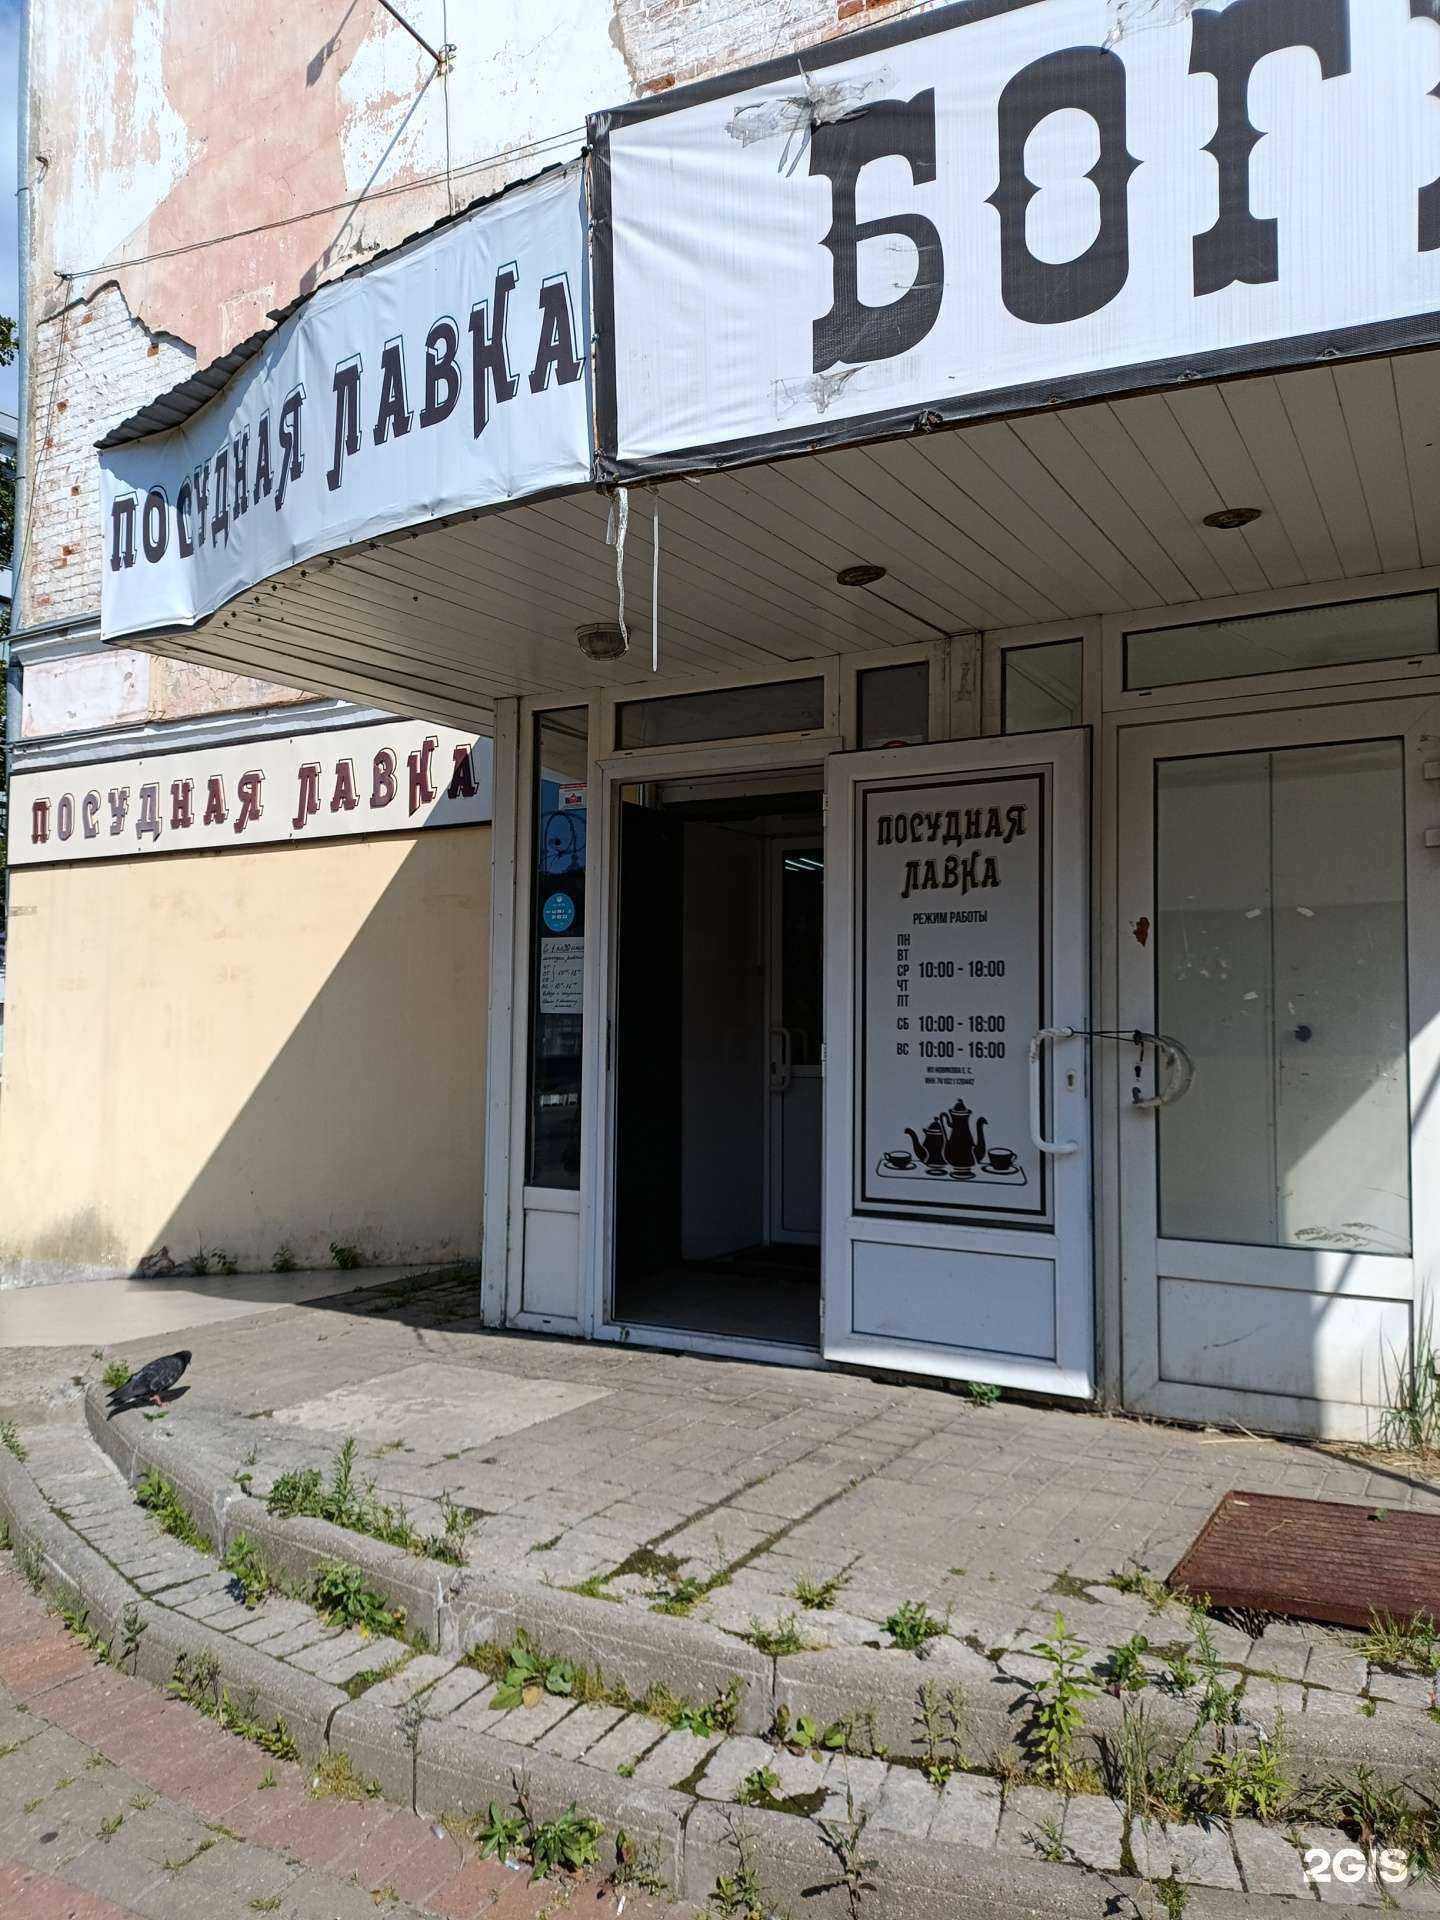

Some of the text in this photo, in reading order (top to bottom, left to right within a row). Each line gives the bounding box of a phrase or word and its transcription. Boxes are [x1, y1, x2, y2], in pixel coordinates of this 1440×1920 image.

[809, 0, 1440, 374] БОГ
[110, 259, 586, 573] ПОСУДНАЯ ЛАВКА
[31, 735, 480, 845] ПОСУДНАЯ ЛАВКА
[877, 803, 1028, 848] ПОСУДНАЯ
[901, 849, 1001, 899] ЛАВКА
[912, 909, 988, 925] РЕЖИМ РАБОТЫ
[896, 933, 911, 947] ПН
[896, 949, 909, 962] ВТ
[896, 964, 910, 977] СР
[918, 961, 955, 978] 10:00
[968, 960, 1006, 977] 18:00
[896, 979, 909, 992] ЧТ
[896, 994, 910, 1007] ПТ
[896, 1017, 910, 1030] СБ
[918, 1015, 955, 1033] 10:00
[968, 1015, 1006, 1033] 18:00
[896, 1042, 909, 1056] ВС
[918, 1041, 955, 1059] 10:00
[968, 1041, 1006, 1059] 16:00
